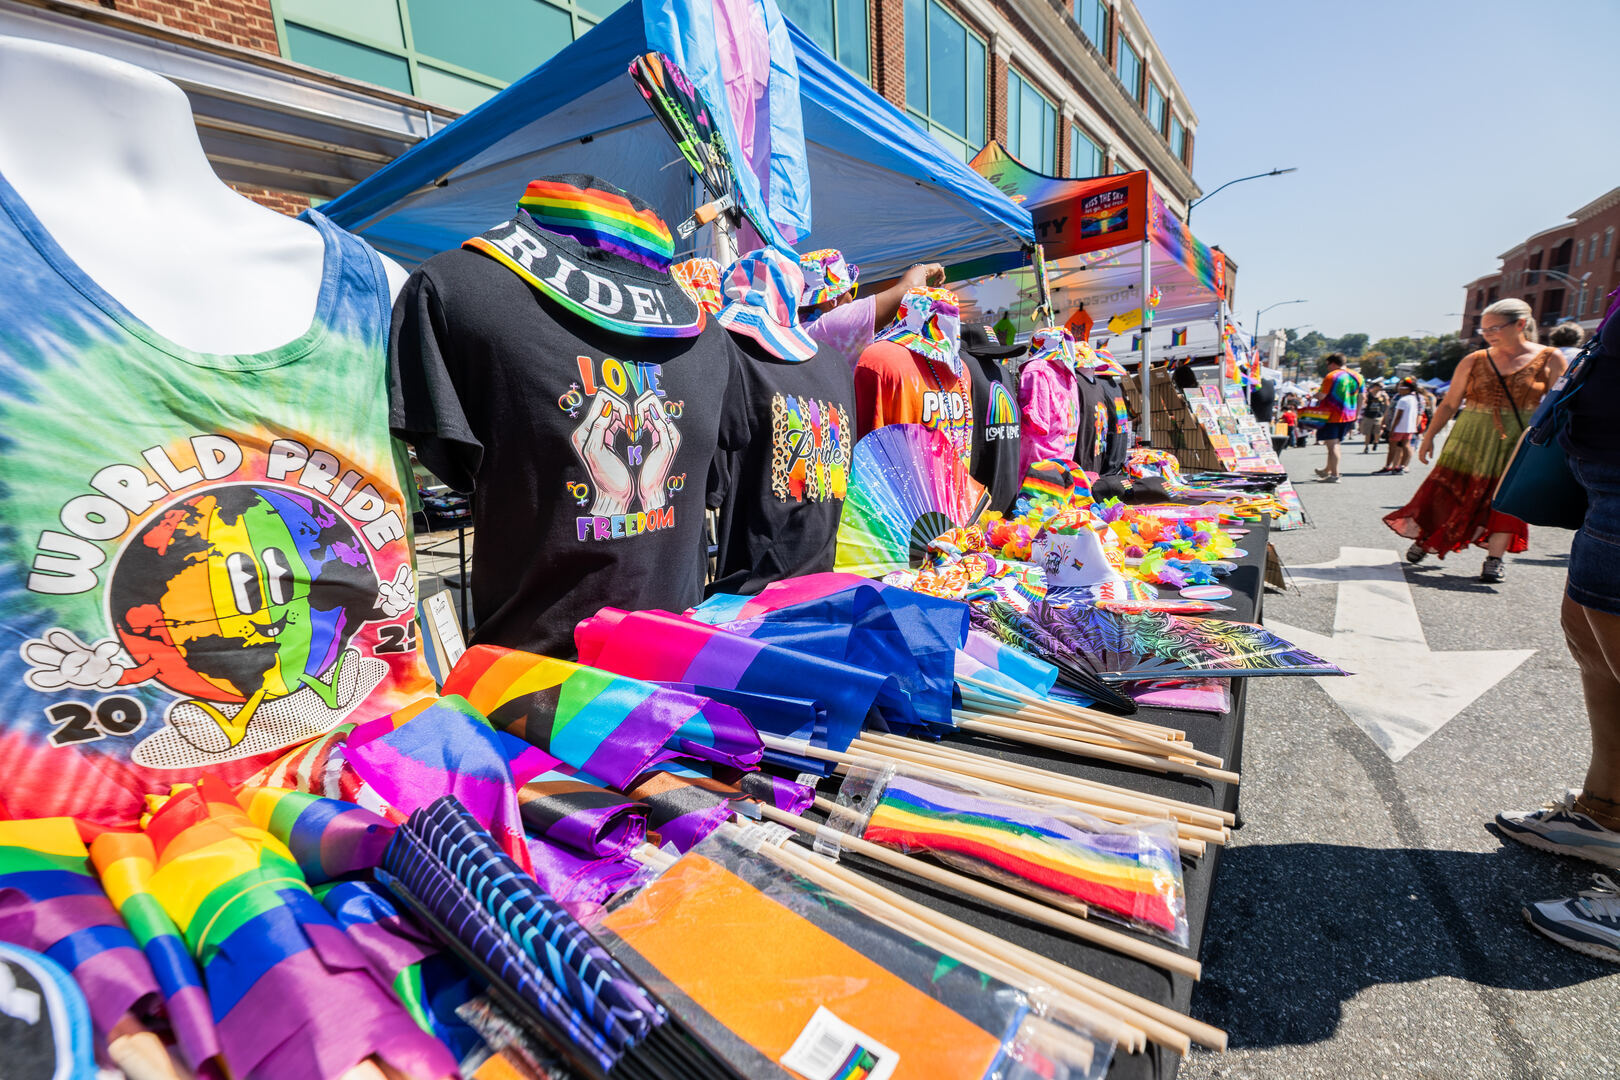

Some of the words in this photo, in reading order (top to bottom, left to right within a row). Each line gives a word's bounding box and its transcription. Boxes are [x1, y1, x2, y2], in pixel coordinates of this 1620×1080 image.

[1099, 191, 1112, 204] THE
[576, 355, 666, 397] LOVE
[626, 444, 643, 466] IS
[785, 429, 845, 474] Pride
[27, 434, 244, 595] WORLD
[266, 438, 406, 551] PRIDE
[576, 506, 674, 542] FREEDOM
[46, 695, 146, 747] 20
